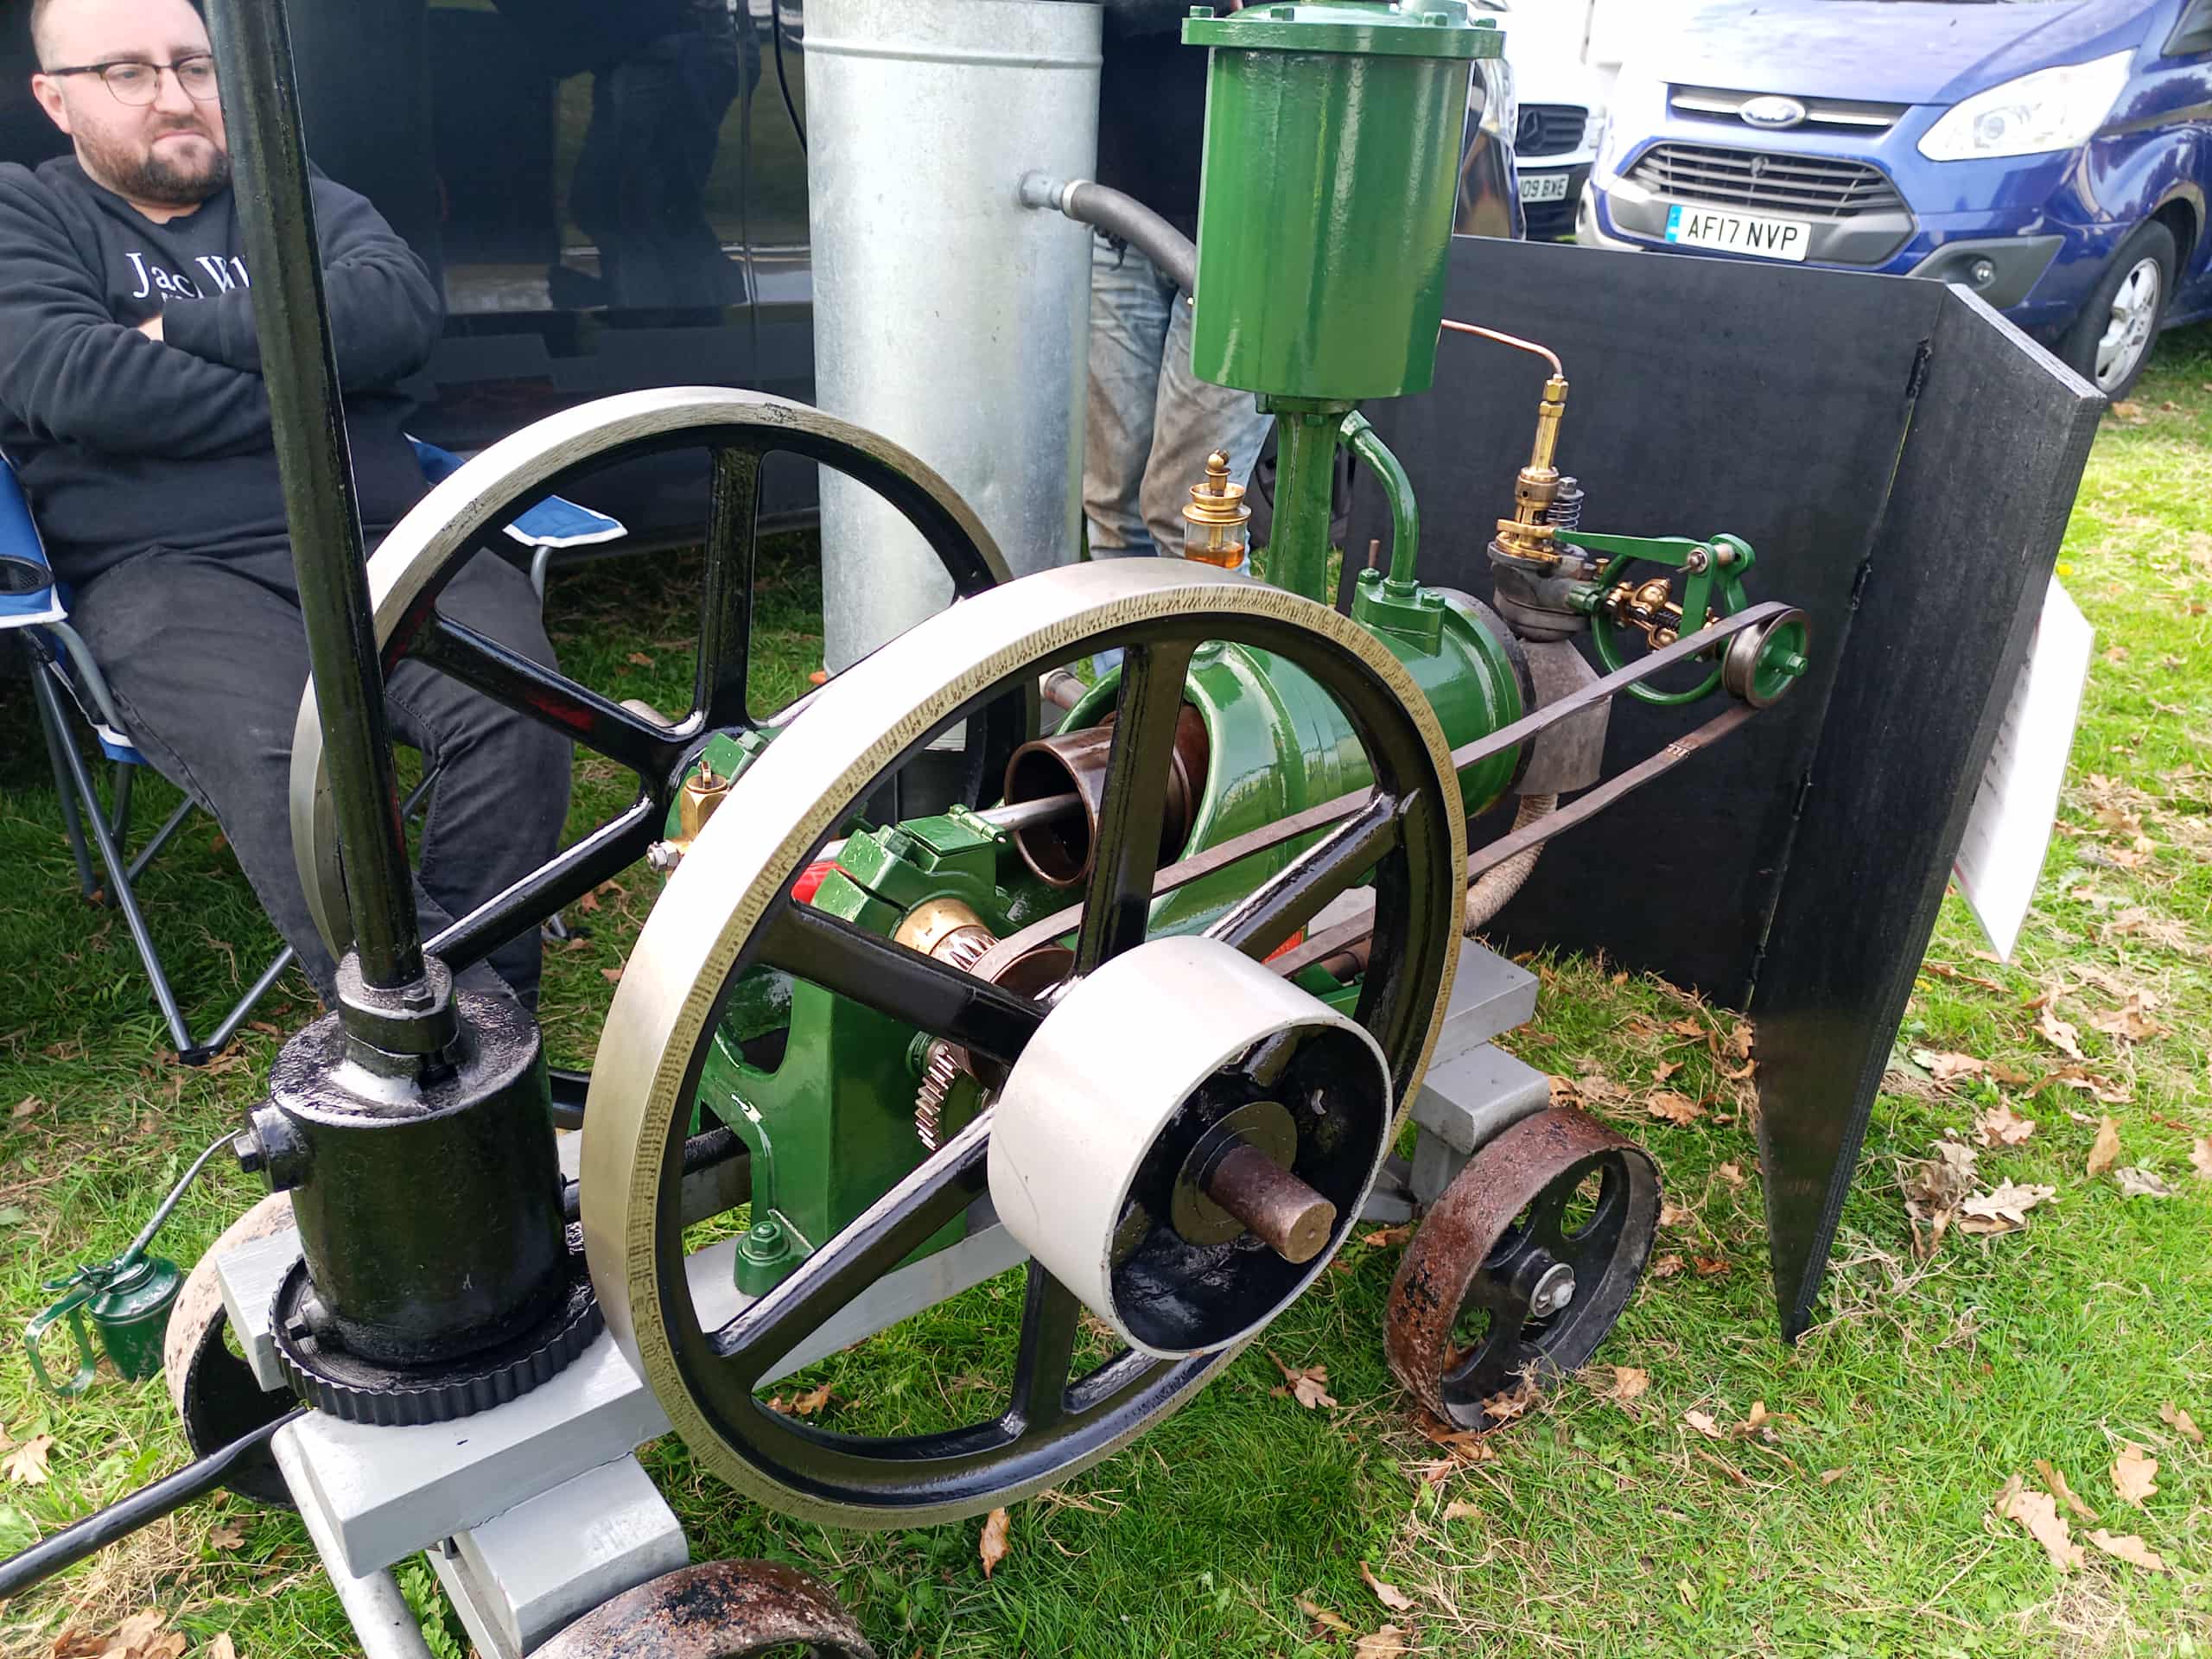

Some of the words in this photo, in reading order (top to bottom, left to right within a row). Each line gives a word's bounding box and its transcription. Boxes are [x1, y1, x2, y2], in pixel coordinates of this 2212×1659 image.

[1520, 179, 1540, 198] 09
[1688, 214, 1739, 243] AF17
[1746, 222, 1797, 250] NVP
